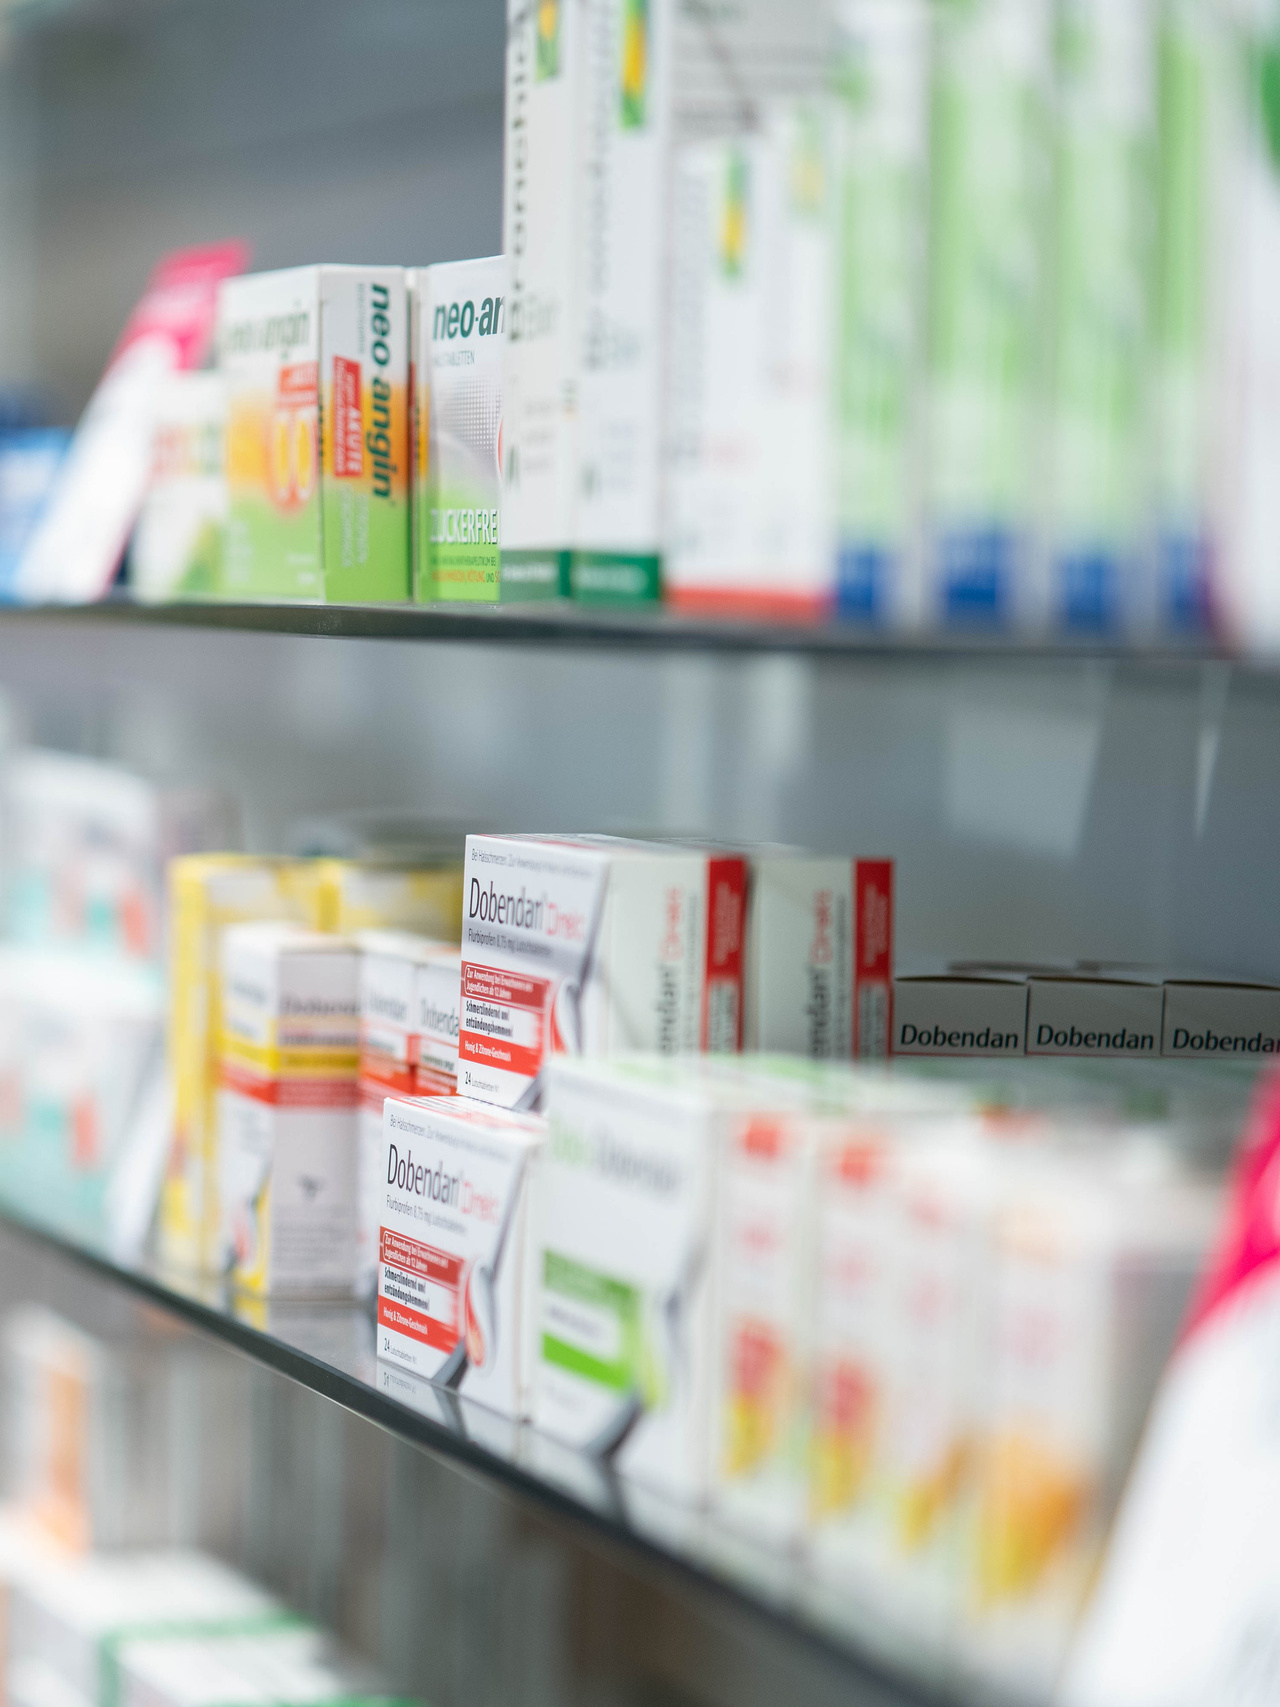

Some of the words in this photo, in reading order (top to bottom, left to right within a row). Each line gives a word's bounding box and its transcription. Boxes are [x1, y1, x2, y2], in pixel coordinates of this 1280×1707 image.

[466, 967, 474, 979] Zur
[474, 969, 495, 985] Anwendung
[900, 1023, 1019, 1049] Dobendan
[1036, 1024, 1154, 1050] Dobendan
[465, 1071, 472, 1085] 24
[384, 1233, 392, 1246] Zur
[392, 1236, 411, 1256] Anwendung
[384, 1337, 391, 1352] 24
